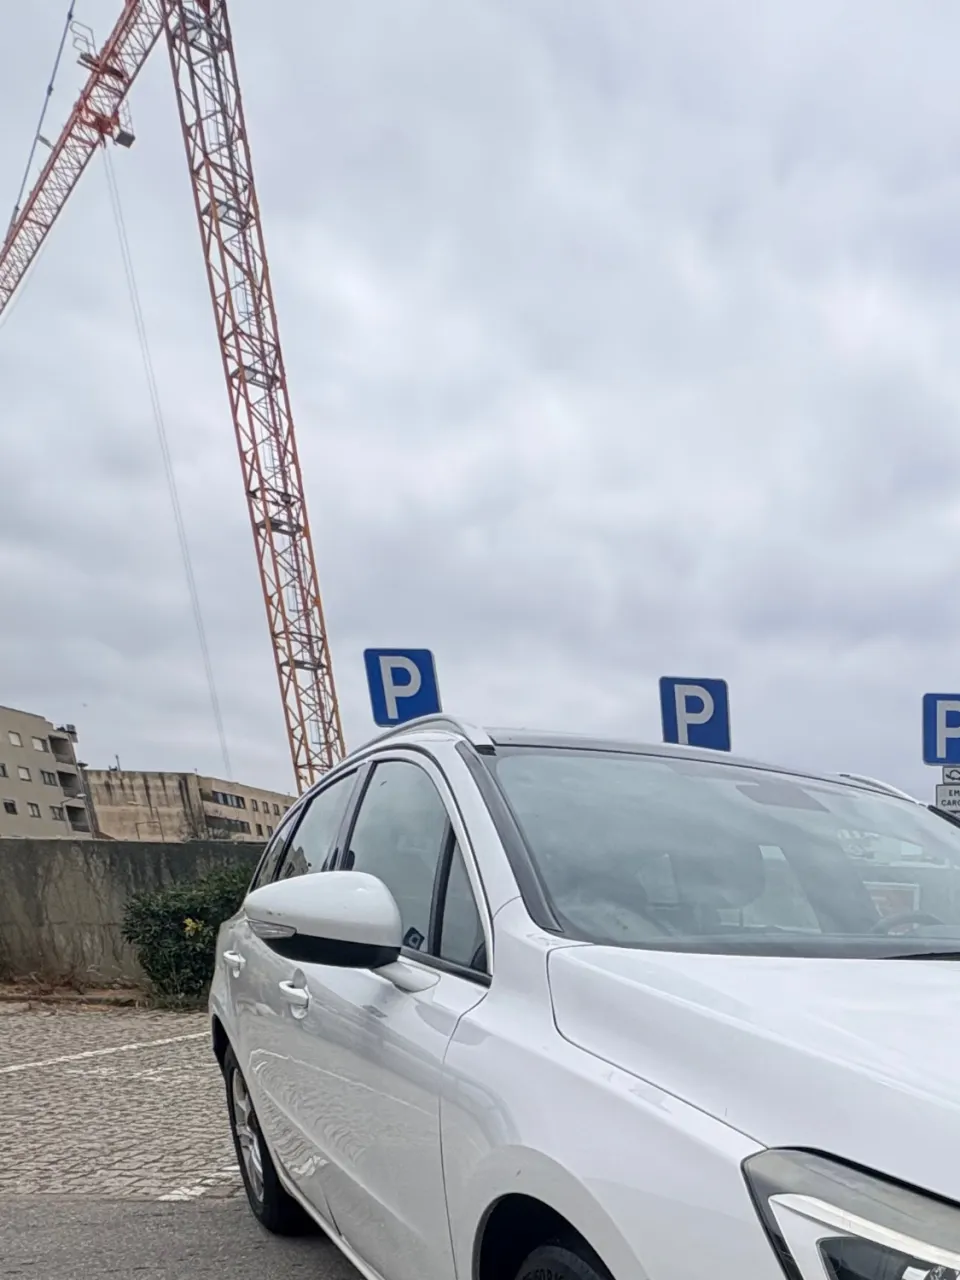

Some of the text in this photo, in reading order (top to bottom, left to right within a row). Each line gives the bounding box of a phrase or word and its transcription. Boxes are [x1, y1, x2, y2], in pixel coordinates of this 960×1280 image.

[379, 655, 421, 719] P
[674, 684, 715, 744] P
[948, 789, 960, 798] EM
